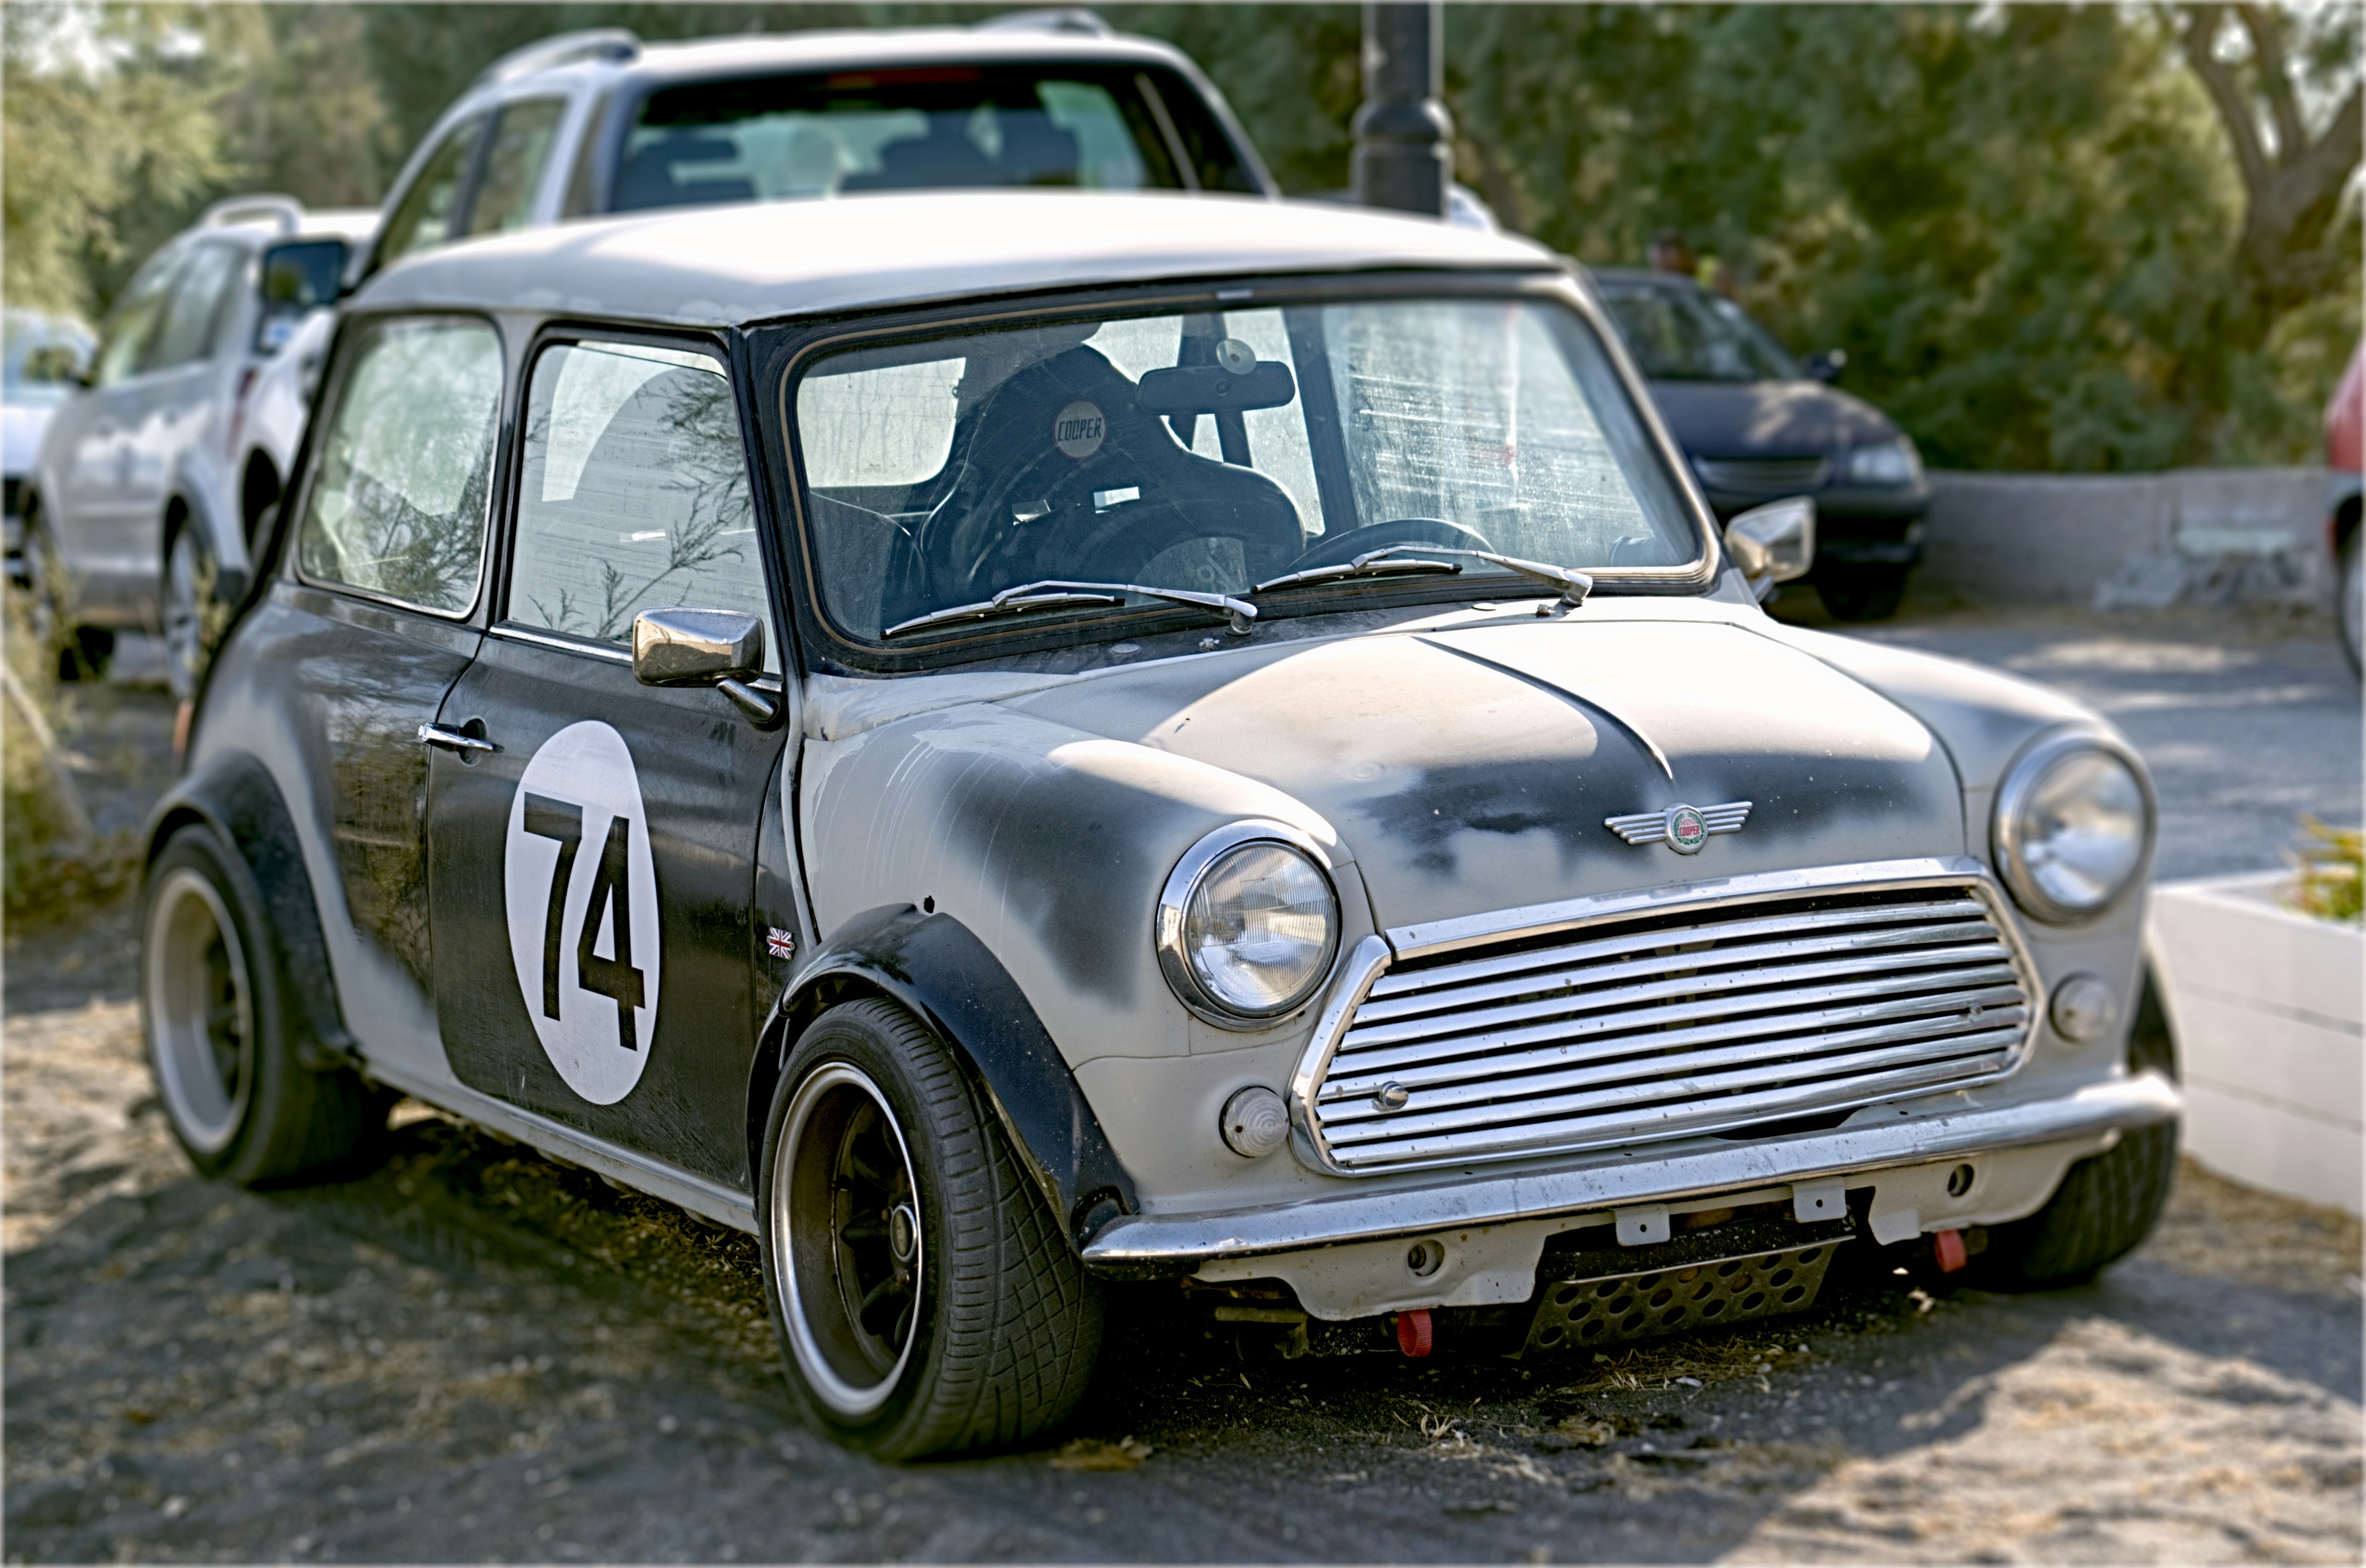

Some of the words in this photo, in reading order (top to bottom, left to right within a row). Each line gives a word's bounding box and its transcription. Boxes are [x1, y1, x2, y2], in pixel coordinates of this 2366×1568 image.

[1058, 418, 1102, 441] COOPER
[1679, 826, 1699, 837] COOPER
[524, 791, 645, 1052] 74
